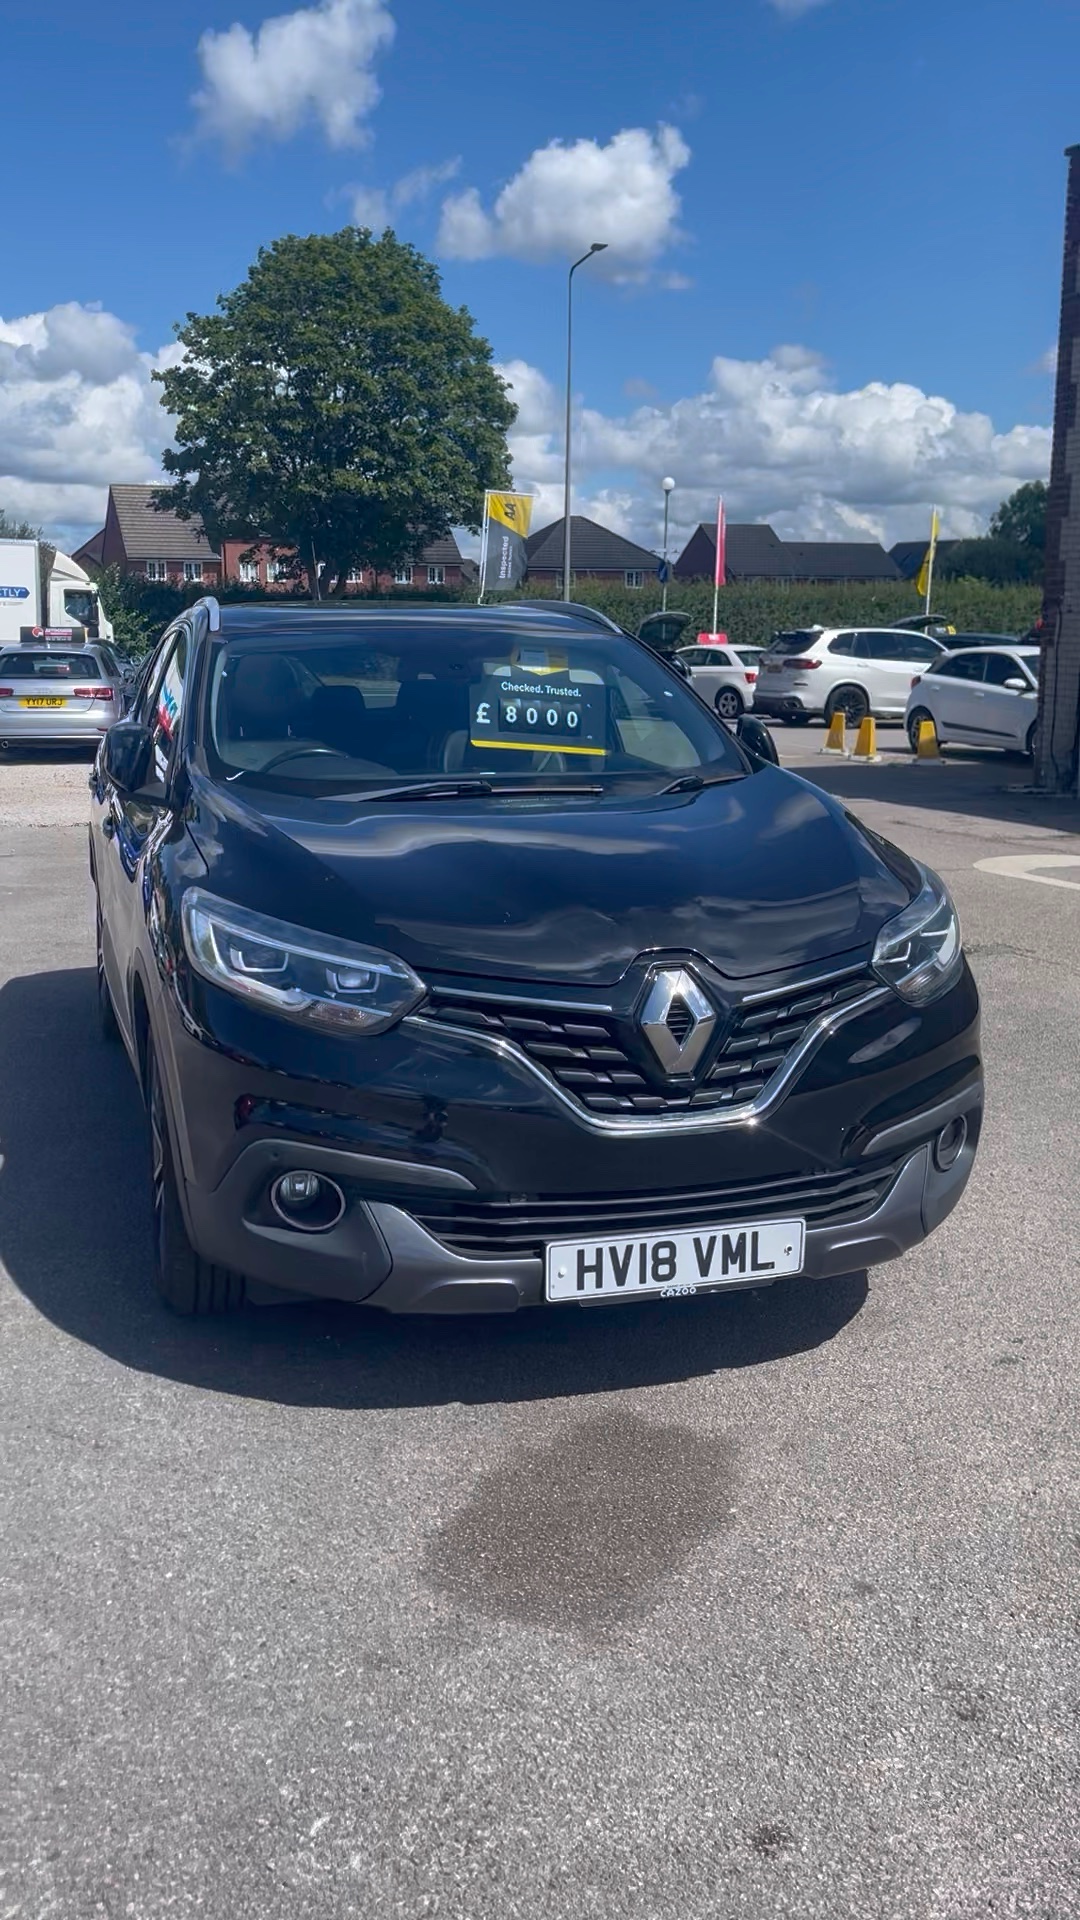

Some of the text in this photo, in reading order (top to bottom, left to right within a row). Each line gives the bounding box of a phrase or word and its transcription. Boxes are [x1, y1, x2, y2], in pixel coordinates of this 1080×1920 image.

[504, 503, 516, 521] AA
[499, 536, 509, 579] Inspected
[0, 588, 20, 596] TLY
[501, 681, 582, 697] Checked. Trusted.
[46, 697, 63, 706] URJ
[576, 1231, 775, 1291] HV18 VML
[660, 1286, 697, 1297] CAZOO
